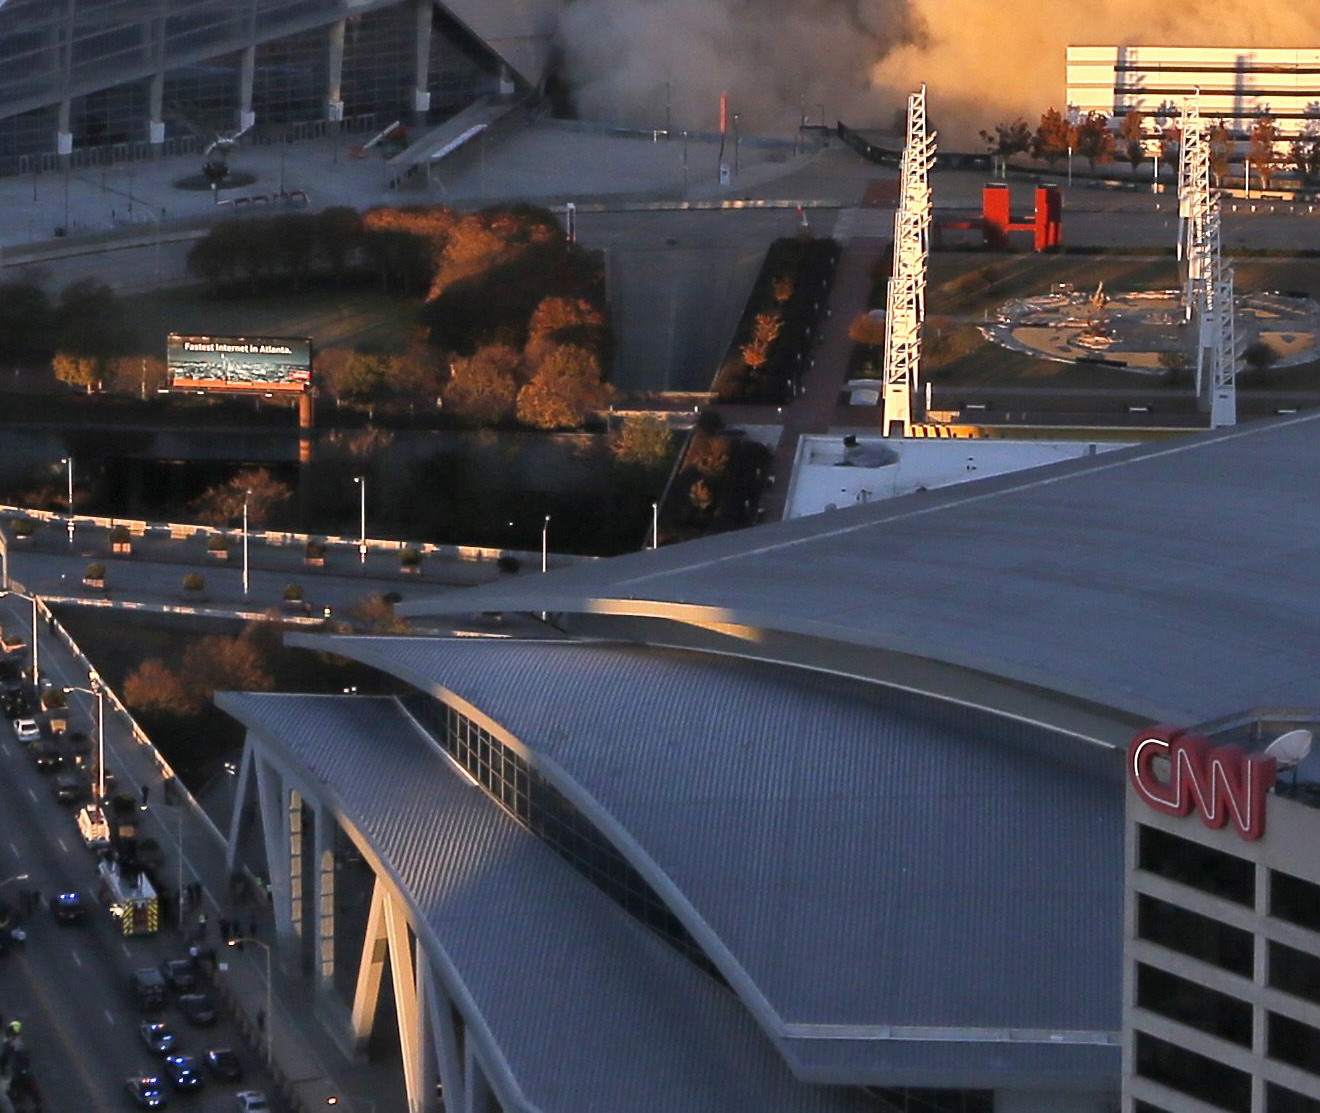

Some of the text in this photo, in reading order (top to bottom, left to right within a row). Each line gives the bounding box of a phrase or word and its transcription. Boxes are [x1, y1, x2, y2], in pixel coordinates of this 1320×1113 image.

[184, 342, 293, 355] Fastest Internet in Atlanta.
[1129, 724, 1276, 841] CNN
